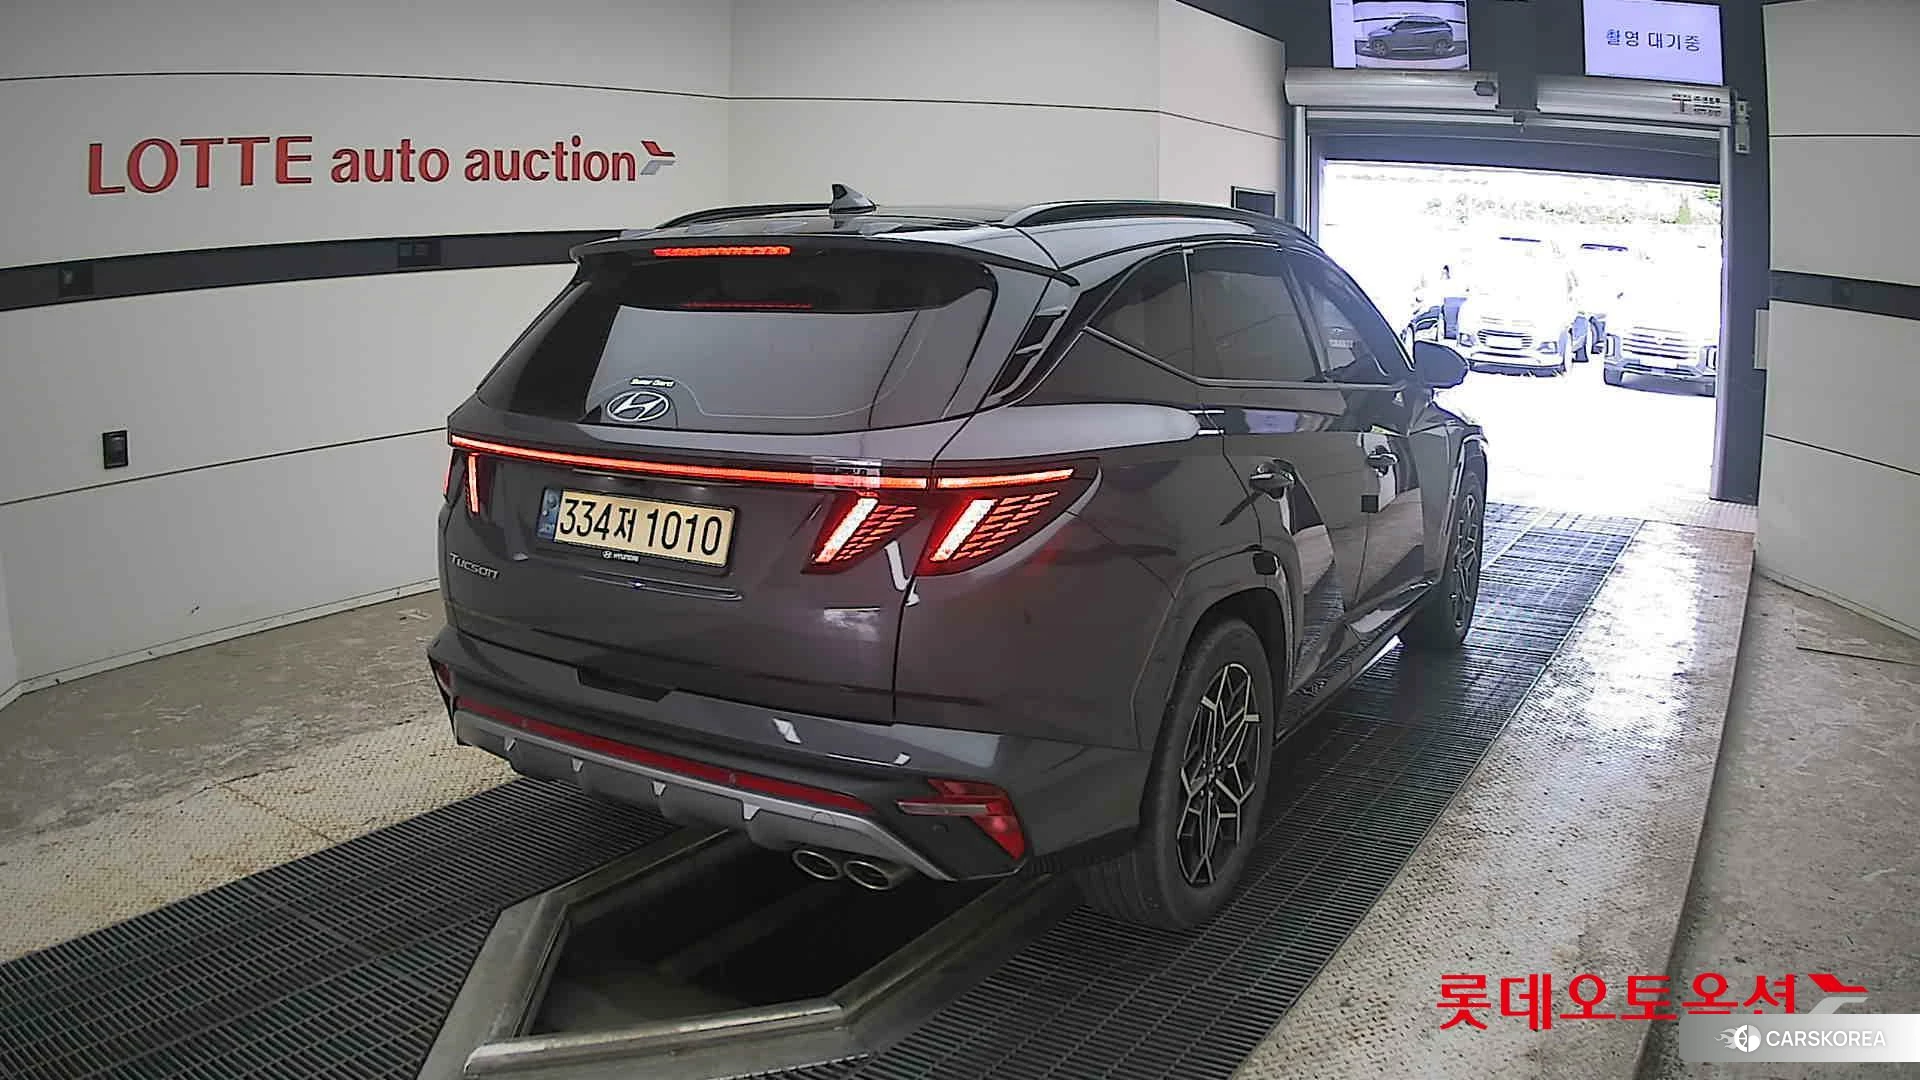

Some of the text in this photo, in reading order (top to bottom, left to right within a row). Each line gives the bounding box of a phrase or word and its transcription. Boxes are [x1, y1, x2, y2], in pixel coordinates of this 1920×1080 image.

[1648, 32, 1701, 52] 대기중
[88, 134, 638, 195] LOTTE auto auction
[559, 498, 722, 556] 334저 1010
